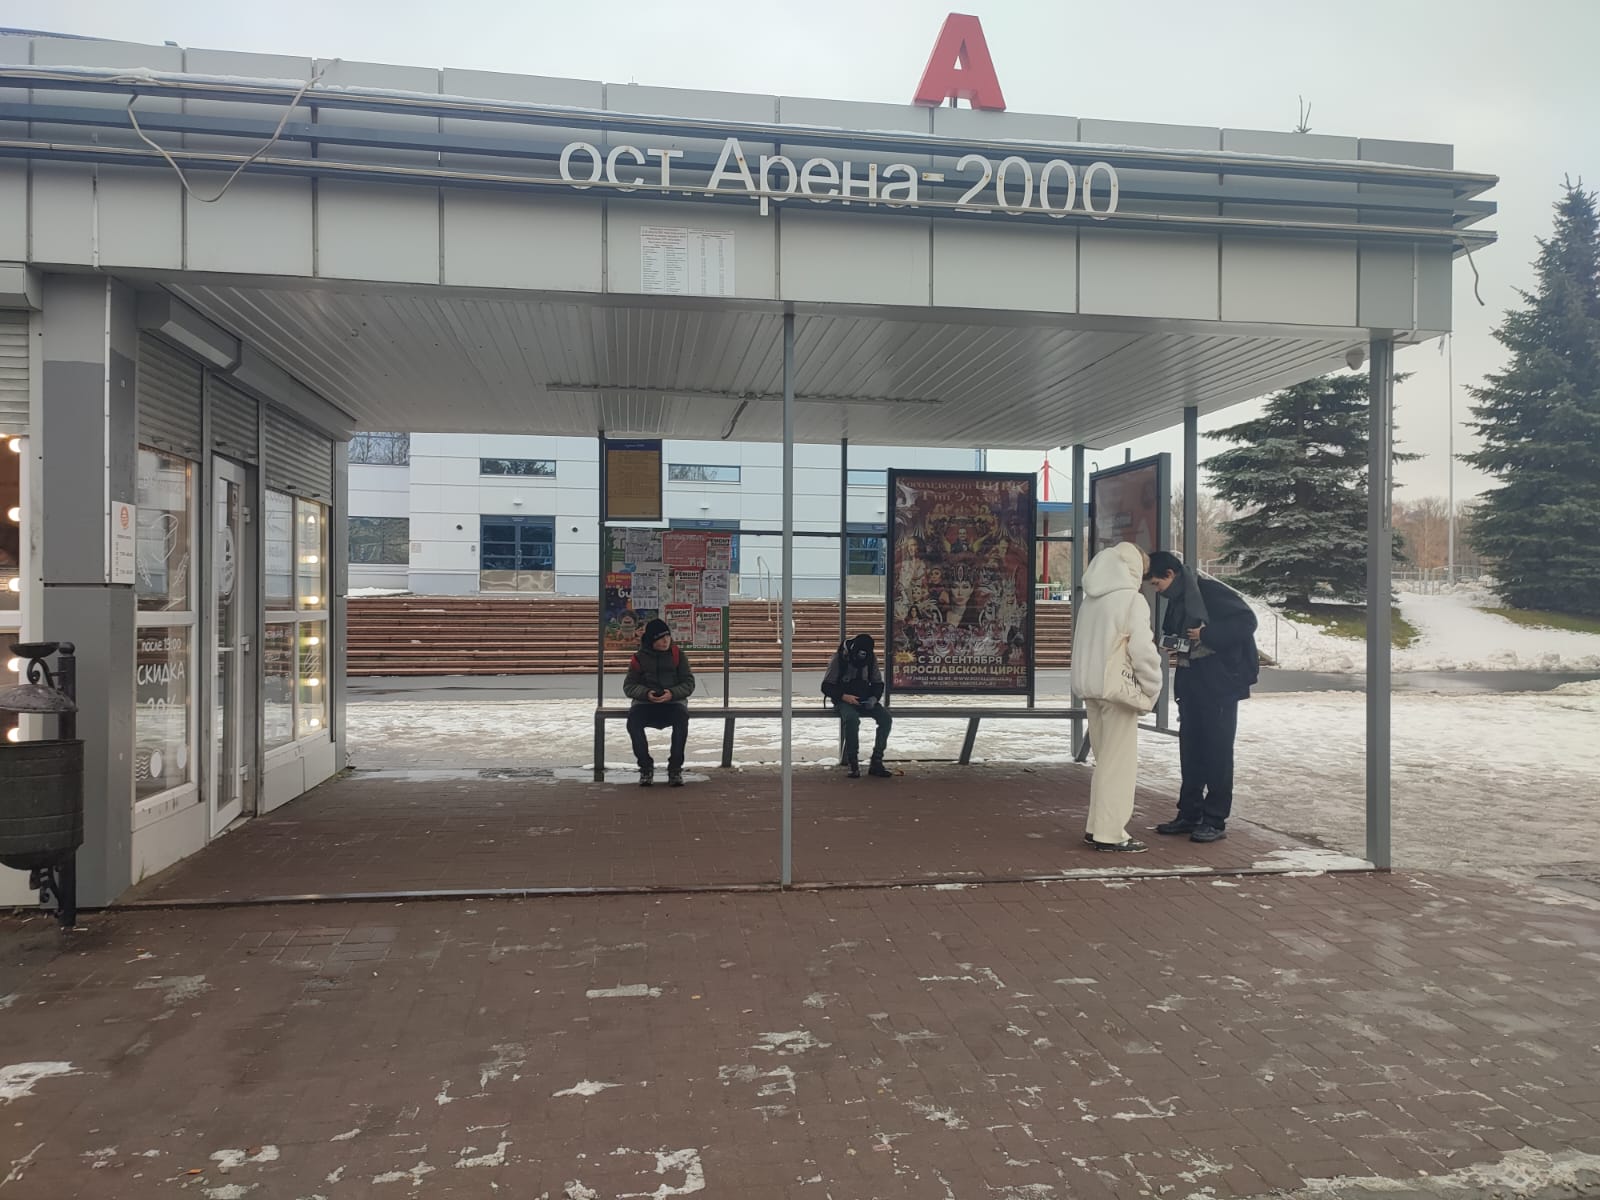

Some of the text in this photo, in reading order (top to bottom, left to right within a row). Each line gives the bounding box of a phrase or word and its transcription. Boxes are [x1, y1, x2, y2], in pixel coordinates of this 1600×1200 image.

[944, 656, 1003, 665] СЕНТЯБРЯ
[137, 661, 185, 686] СКИДКА
[903, 665, 987, 675] ЯРОСЛАВСКОМ
[990, 666, 1027, 676] ЦИРКЕ
